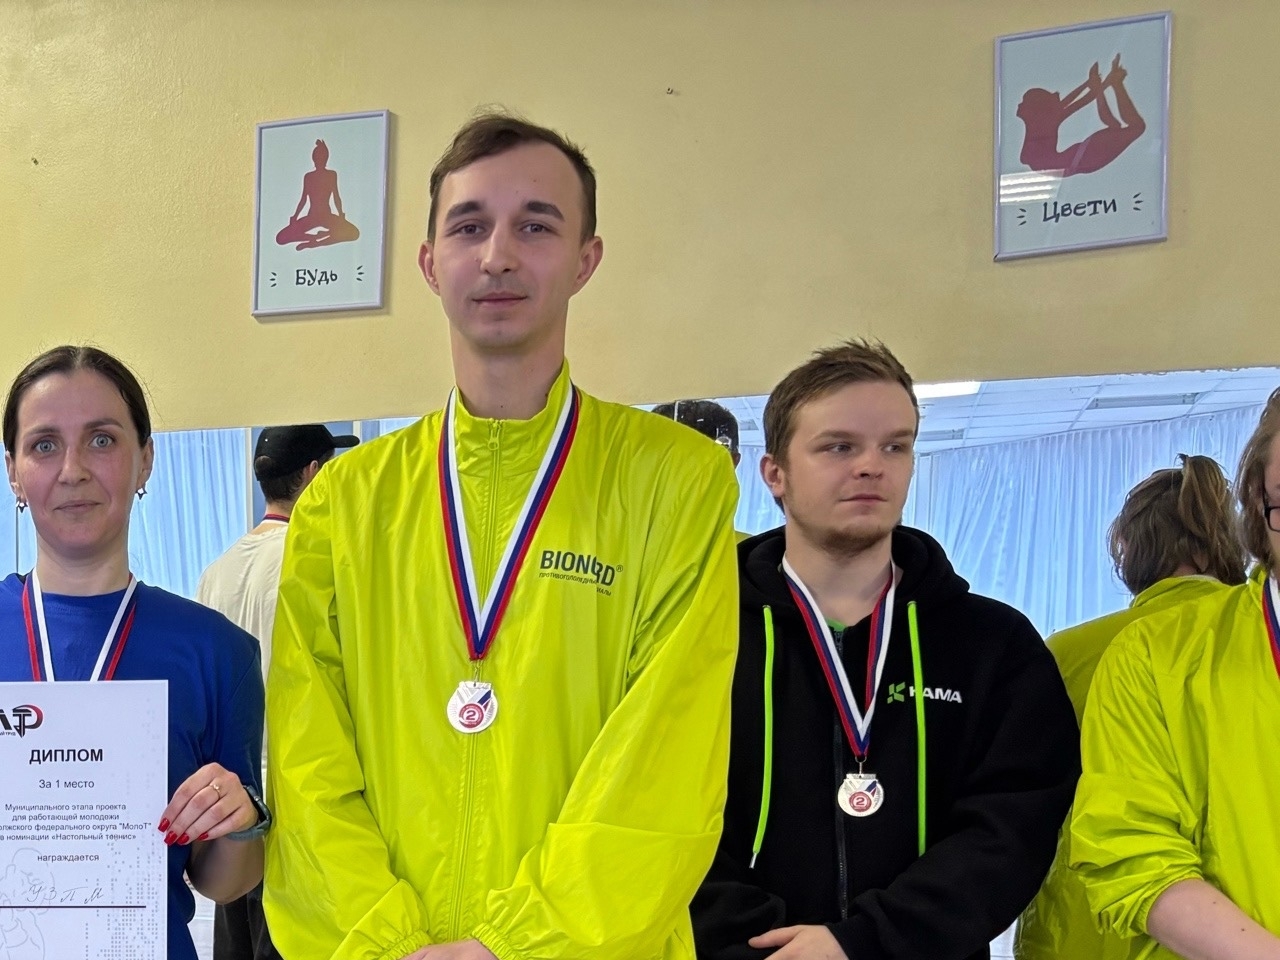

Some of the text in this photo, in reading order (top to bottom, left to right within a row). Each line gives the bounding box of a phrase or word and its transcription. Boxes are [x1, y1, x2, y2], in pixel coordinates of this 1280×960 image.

[1043, 198, 1117, 223] Цвети
[465, 710, 476, 721] 2
[29, 748, 103, 765] ДИПЛОМ
[39, 779, 94, 789] За 1 место
[856, 797, 865, 806] 2
[5, 803, 69, 812] Муниципального
[96, 804, 126, 812] проекта
[12, 814, 27, 822] для
[29, 813, 78, 822] работающей
[35, 823, 90, 833] федерального
[93, 824, 117, 832] округа
[6, 834, 49, 842] номинации
[37, 854, 99, 862] награждается
